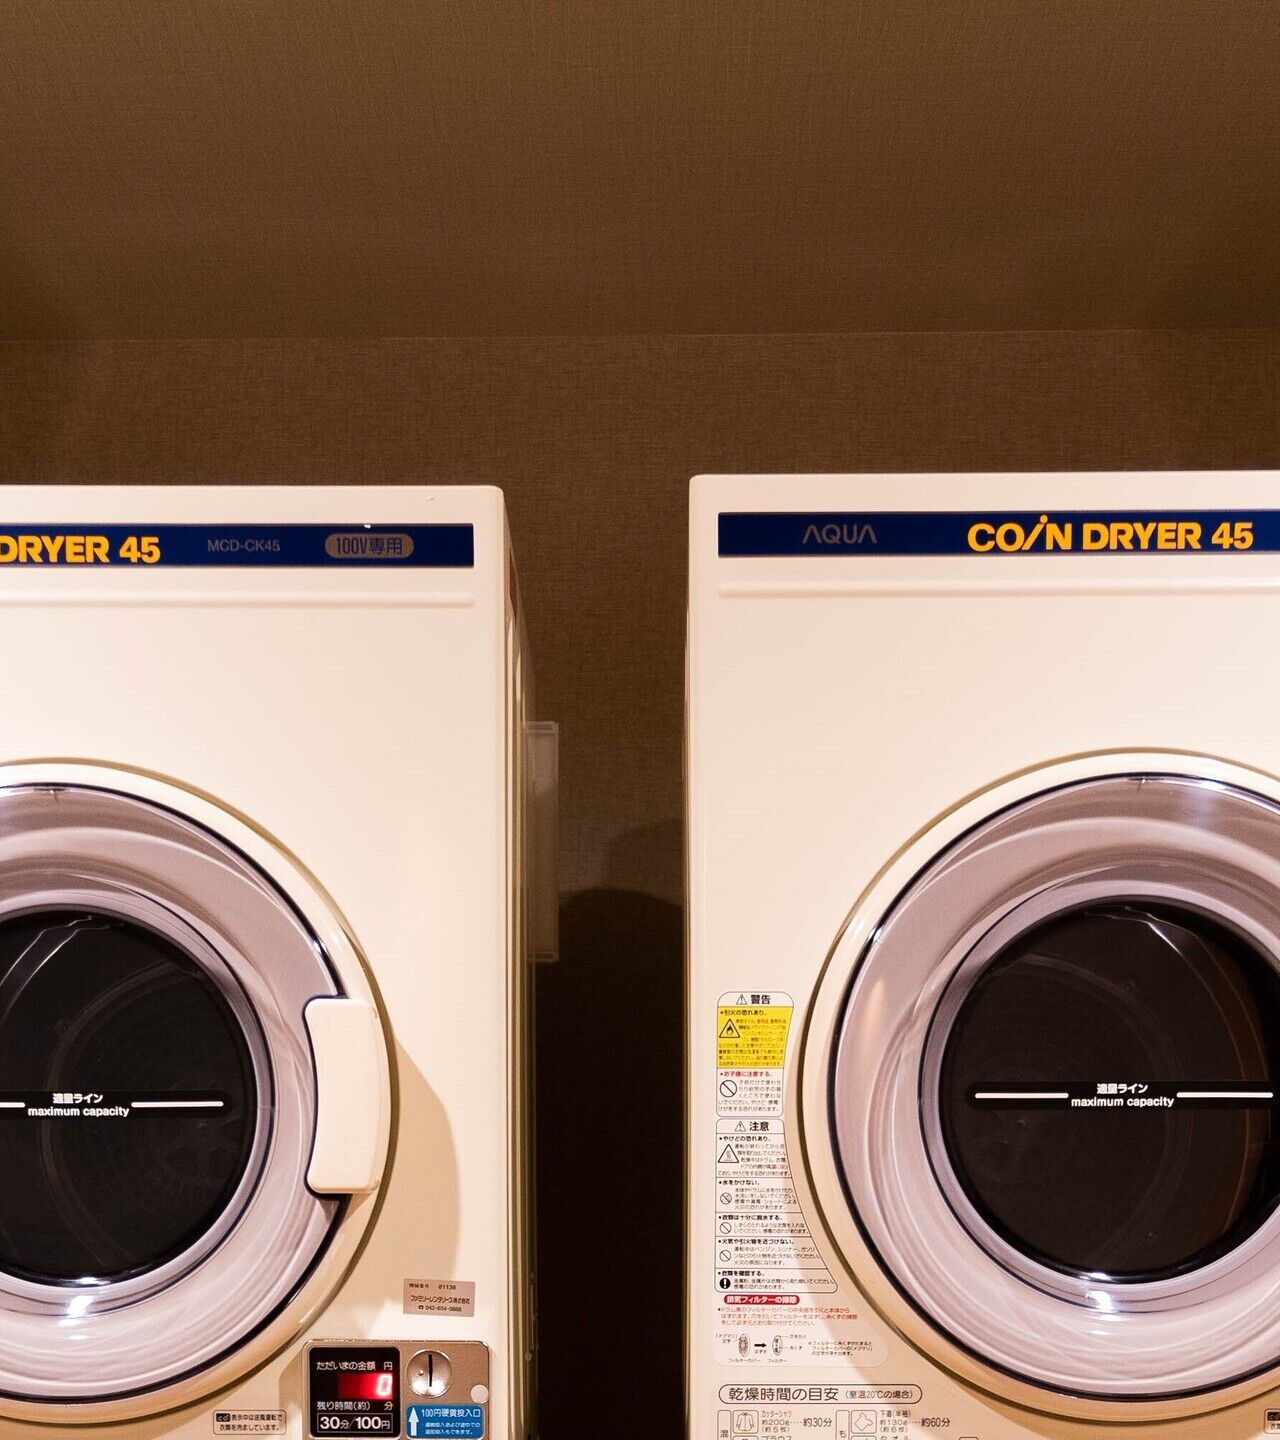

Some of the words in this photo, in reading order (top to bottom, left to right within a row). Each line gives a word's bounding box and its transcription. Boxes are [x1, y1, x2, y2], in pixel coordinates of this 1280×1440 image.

[803, 524, 877, 545] AQUA
[1082, 523, 1201, 551] DRYER
[1211, 523, 1253, 549] 45
[119, 536, 160, 562] 45
[208, 540, 280, 552] MCD-CK45
[751, 994, 771, 1005] 警告
[1072, 1098, 1123, 1106] maximum
[1127, 1097, 1174, 1107] capacity
[28, 1107, 80, 1115] maximum
[83, 1107, 129, 1117] capacity
[749, 1121, 769, 1131] 注意
[728, 1387, 838, 1401] 乾燥時間の目安
